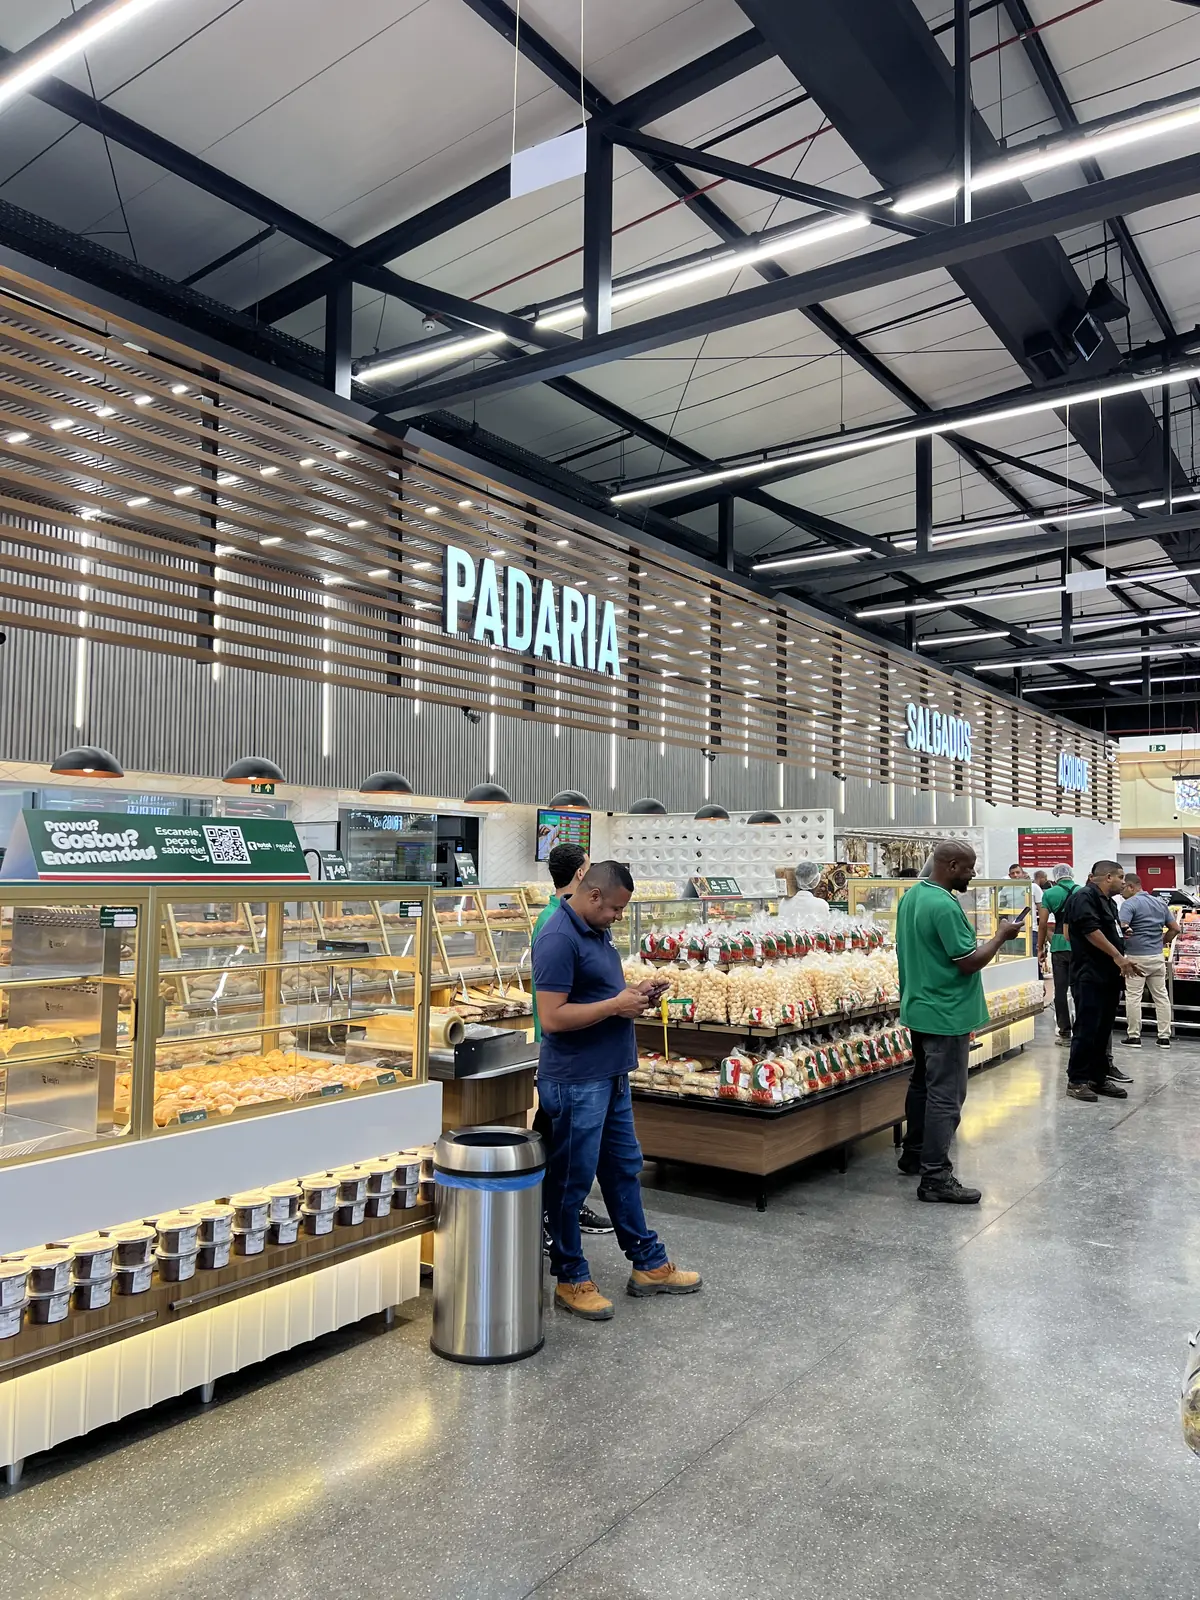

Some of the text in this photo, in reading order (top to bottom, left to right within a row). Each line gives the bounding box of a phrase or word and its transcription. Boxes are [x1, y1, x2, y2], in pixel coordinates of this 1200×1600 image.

[445, 544, 621, 677] PADARIA
[904, 702, 972, 763] SALGADOS
[1058, 752, 1089, 793] AÇOUGUE
[44, 819, 99, 832] Provou?
[155, 827, 202, 837] Escaneie,
[51, 829, 139, 849] Gostou?
[165, 837, 190, 847] peça
[41, 845, 158, 865] Encomendou!
[161, 845, 206, 855] saboreie!
